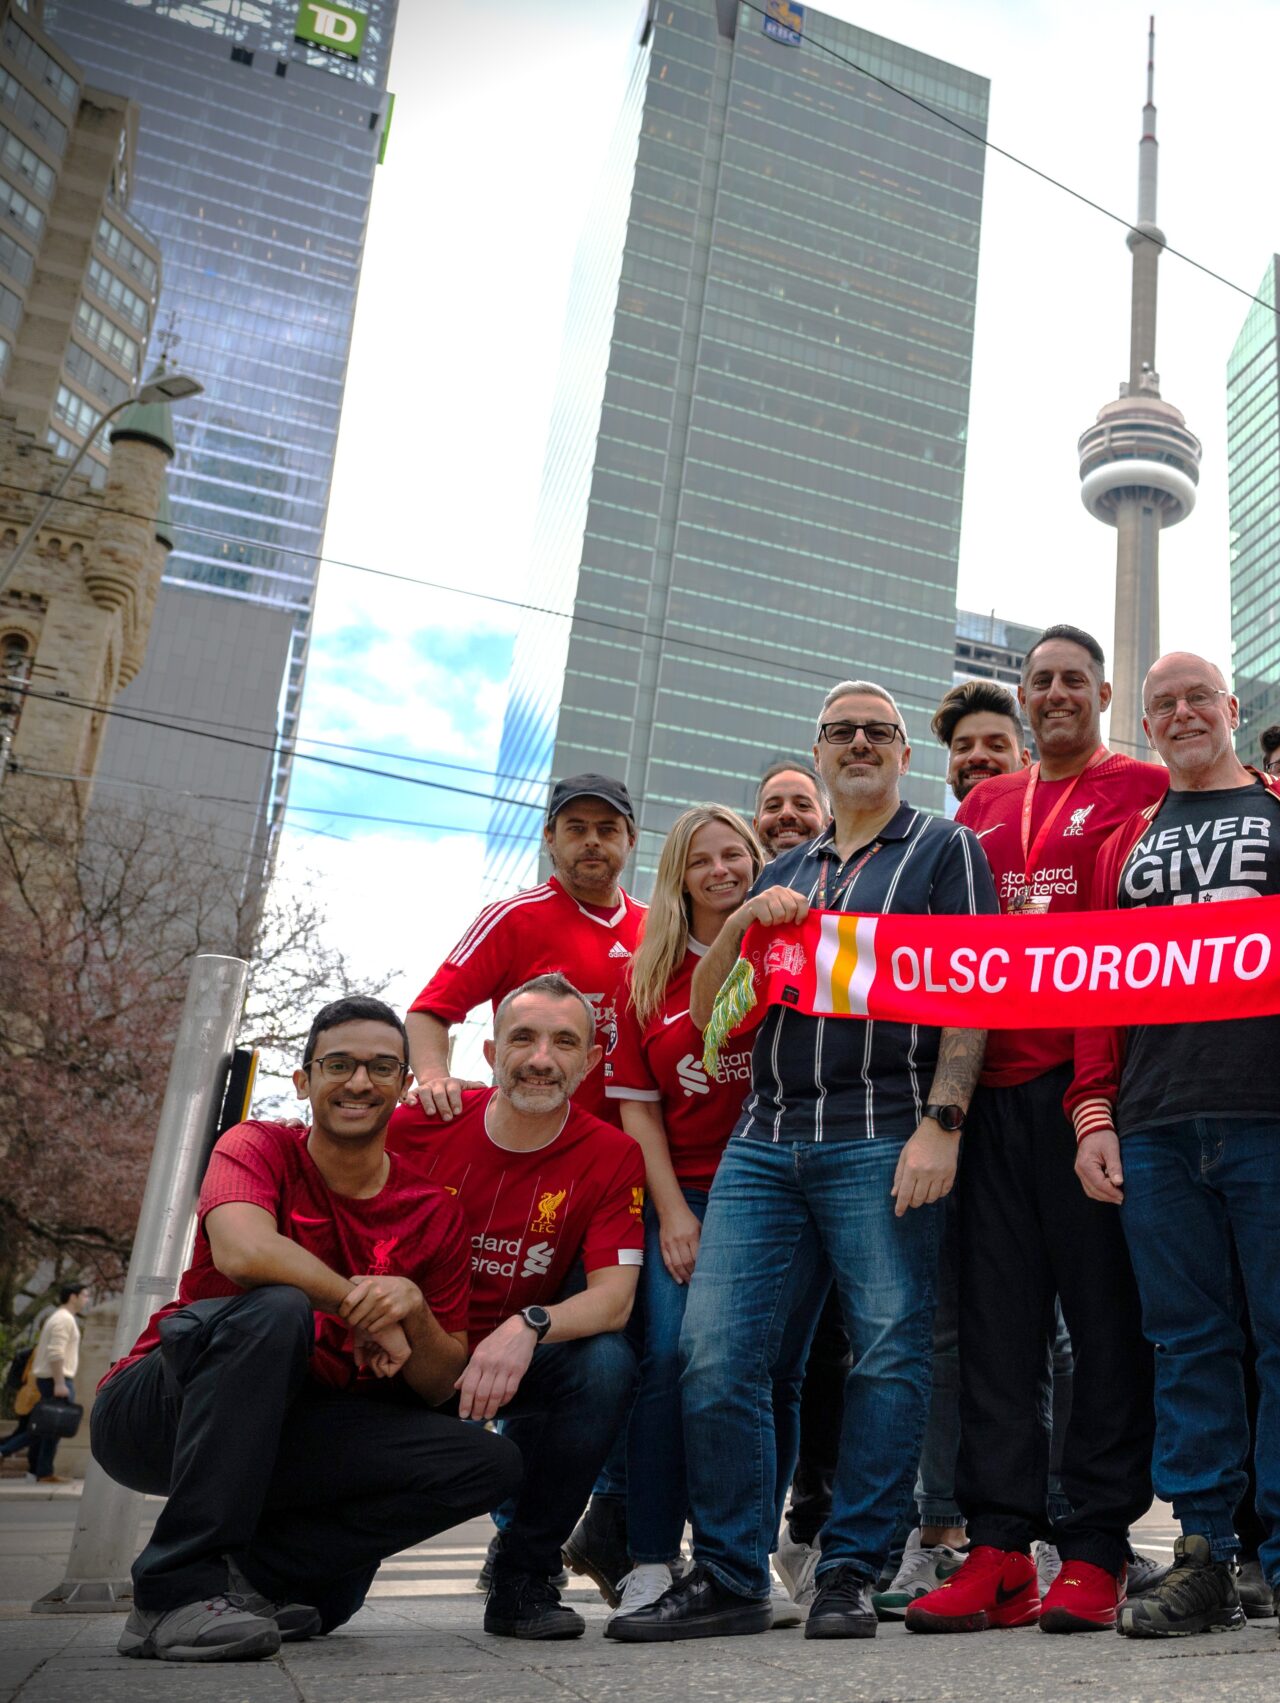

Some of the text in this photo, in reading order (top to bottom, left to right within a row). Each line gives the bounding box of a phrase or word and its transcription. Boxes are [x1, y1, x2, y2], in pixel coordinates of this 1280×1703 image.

[307, 3, 357, 43] TD
[1131, 816, 1271, 863] NEVER
[1001, 865, 1073, 885] stadard
[1124, 838, 1270, 899] GIVE
[891, 933, 1271, 994] OLSC TORONTO
